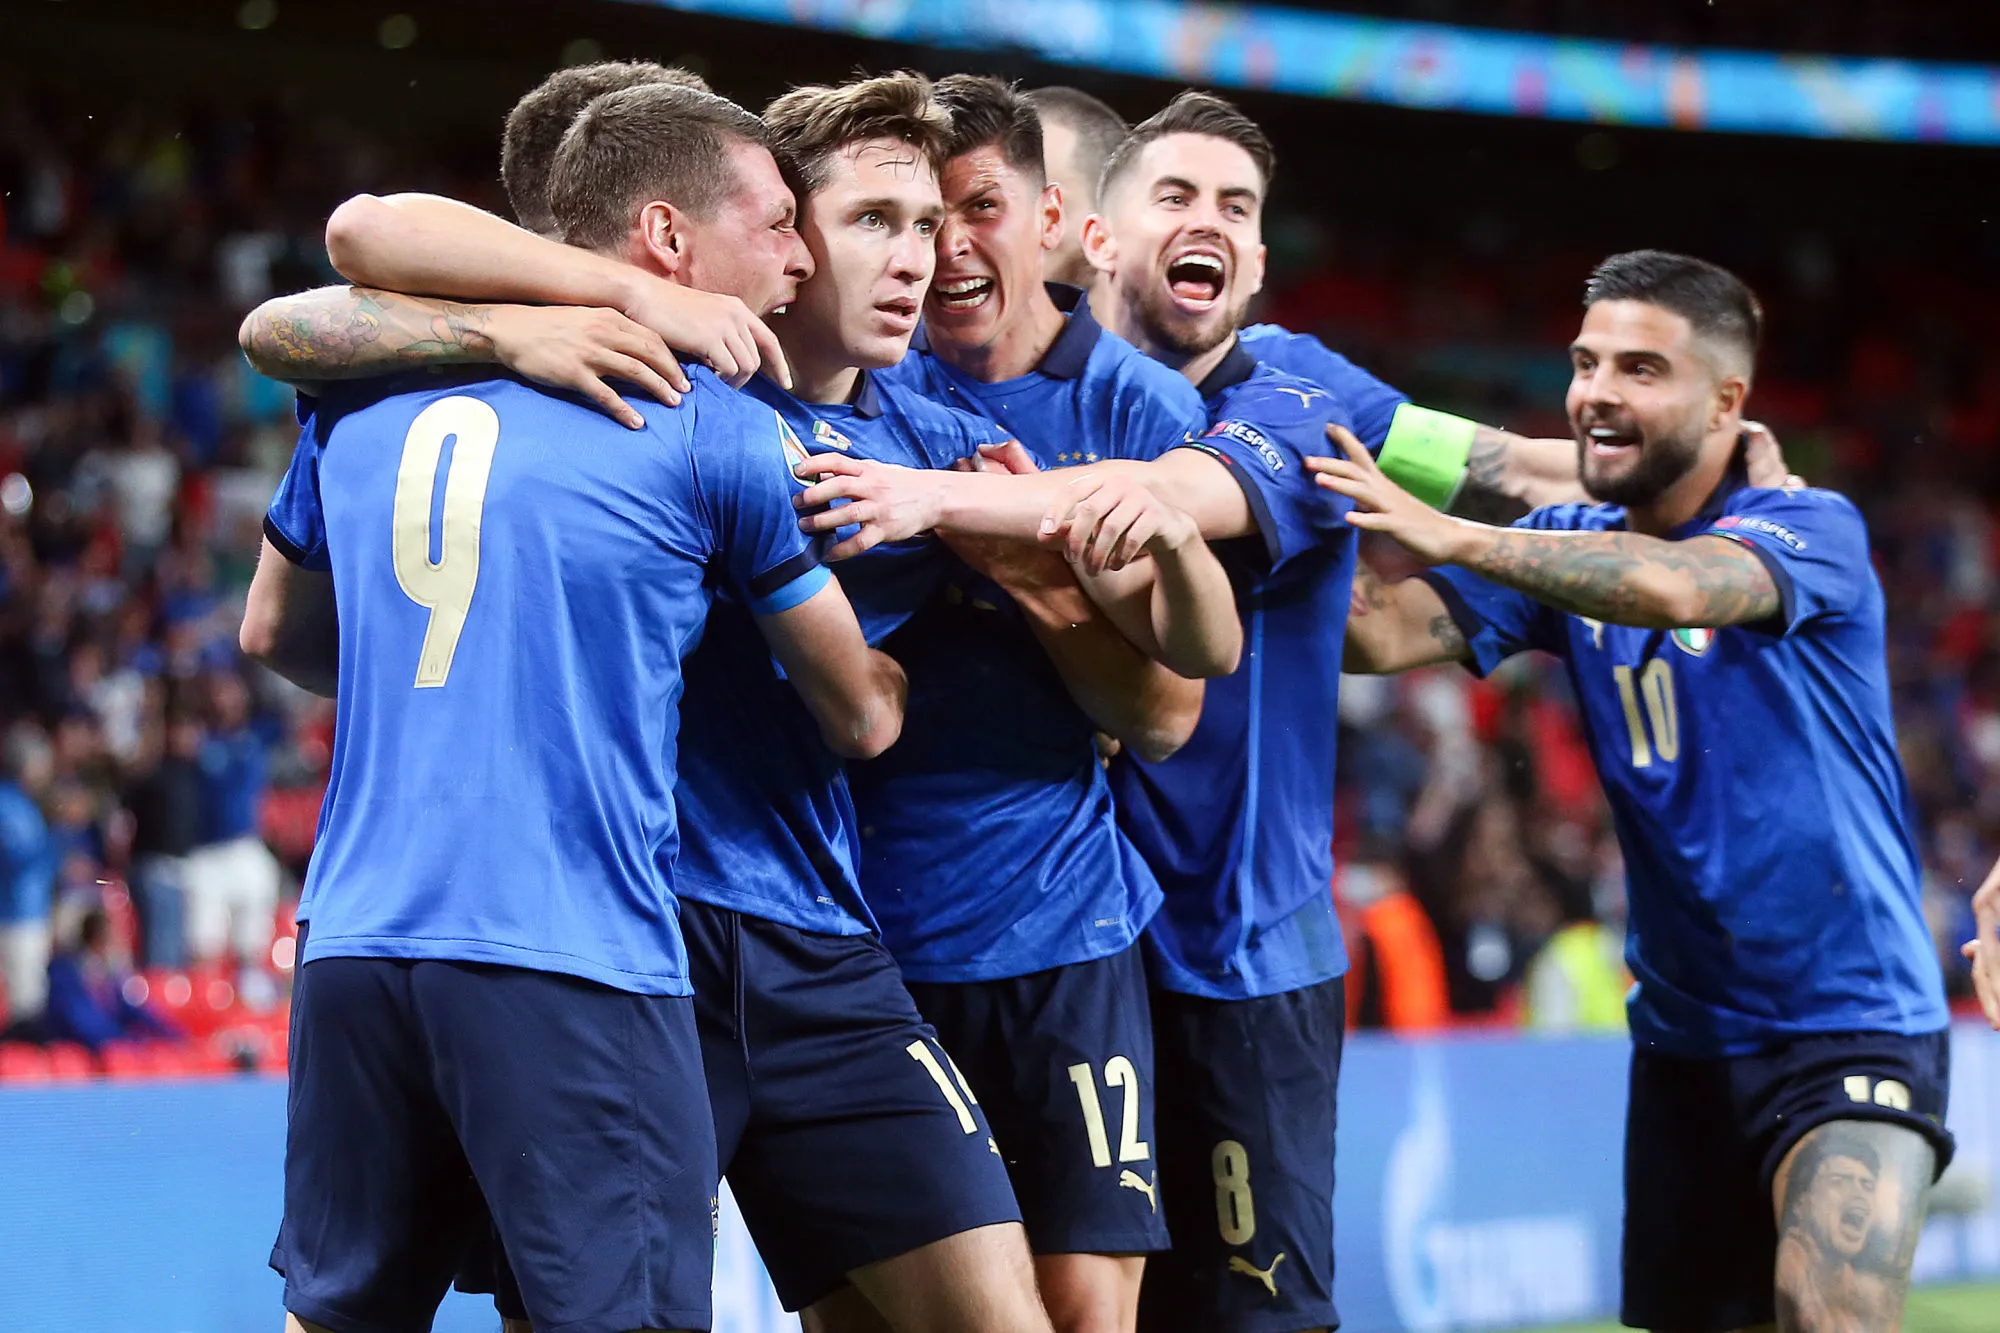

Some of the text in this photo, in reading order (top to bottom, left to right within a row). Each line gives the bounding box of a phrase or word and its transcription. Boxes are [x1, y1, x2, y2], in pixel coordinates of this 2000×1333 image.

[1224, 421, 1284, 471] RESPECT
[393, 396, 500, 688] 9
[1739, 517, 1808, 551] RESPECT
[1613, 658, 1679, 768] 10
[1068, 1056, 1150, 1167] 12
[1212, 1140, 1255, 1244] 8
